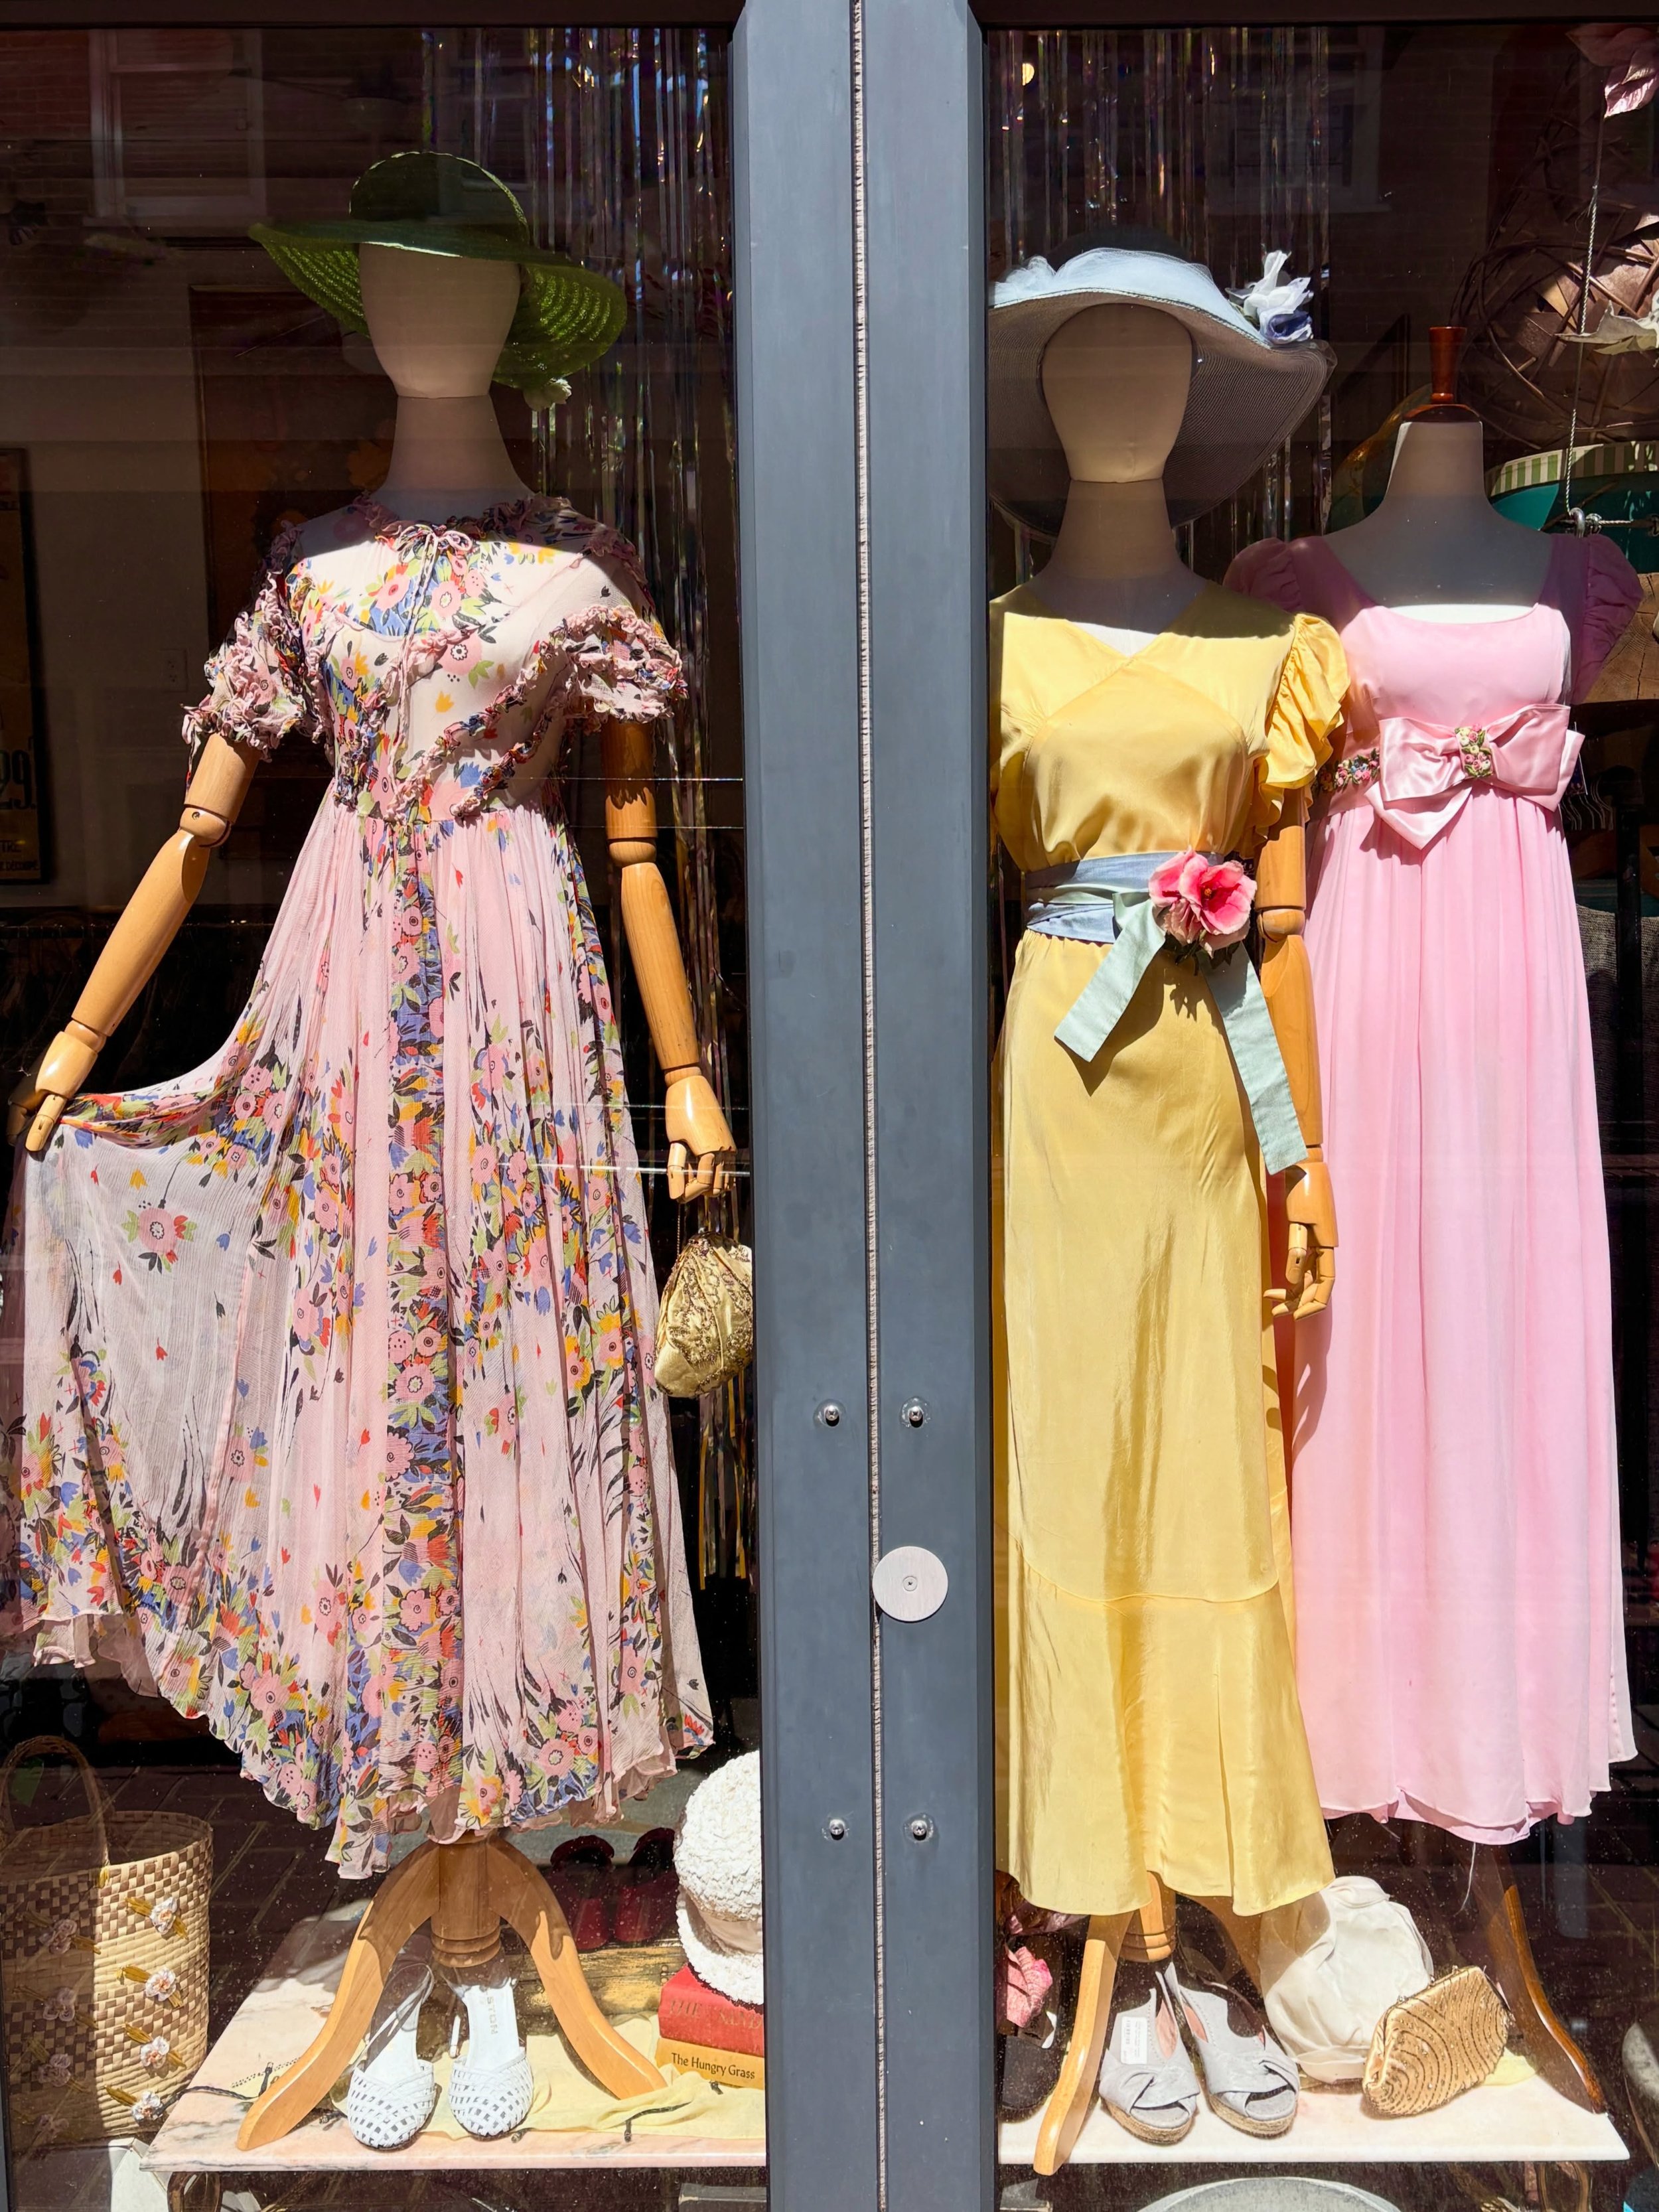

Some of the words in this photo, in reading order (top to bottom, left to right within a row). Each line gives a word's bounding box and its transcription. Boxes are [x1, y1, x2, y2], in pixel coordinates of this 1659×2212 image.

[670, 2000, 701, 2018] THE
[671, 2052, 689, 2067] The
[691, 2057, 727, 2077] Hungry
[728, 2065, 755, 2079] Grass
